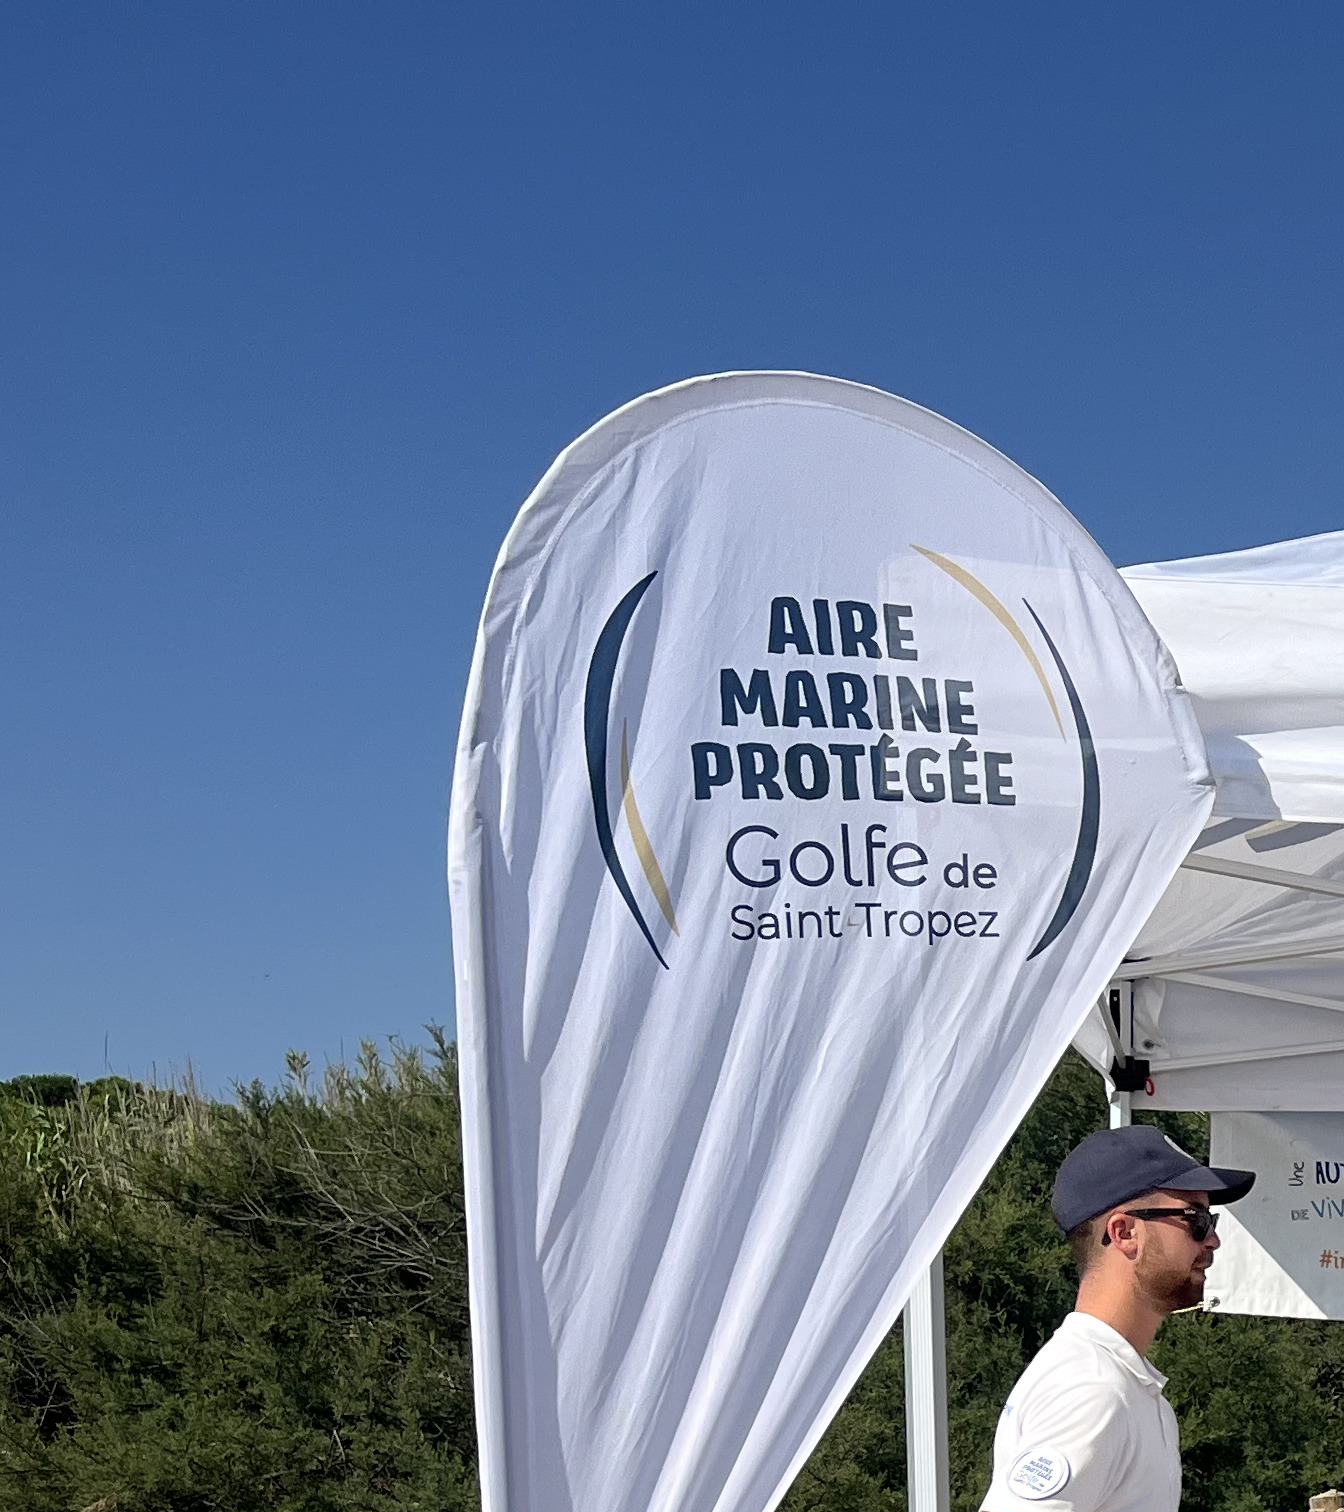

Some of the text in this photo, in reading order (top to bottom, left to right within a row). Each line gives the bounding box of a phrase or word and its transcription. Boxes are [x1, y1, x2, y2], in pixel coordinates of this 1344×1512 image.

[768, 596, 918, 661] AIRE
[720, 668, 978, 735] MARINE
[691, 733, 1016, 806] PROTÉGÉE
[726, 823, 997, 888] Golfe de
[1288, 1161, 1304, 1187] Une
[1291, 1209, 1309, 1221] DE
